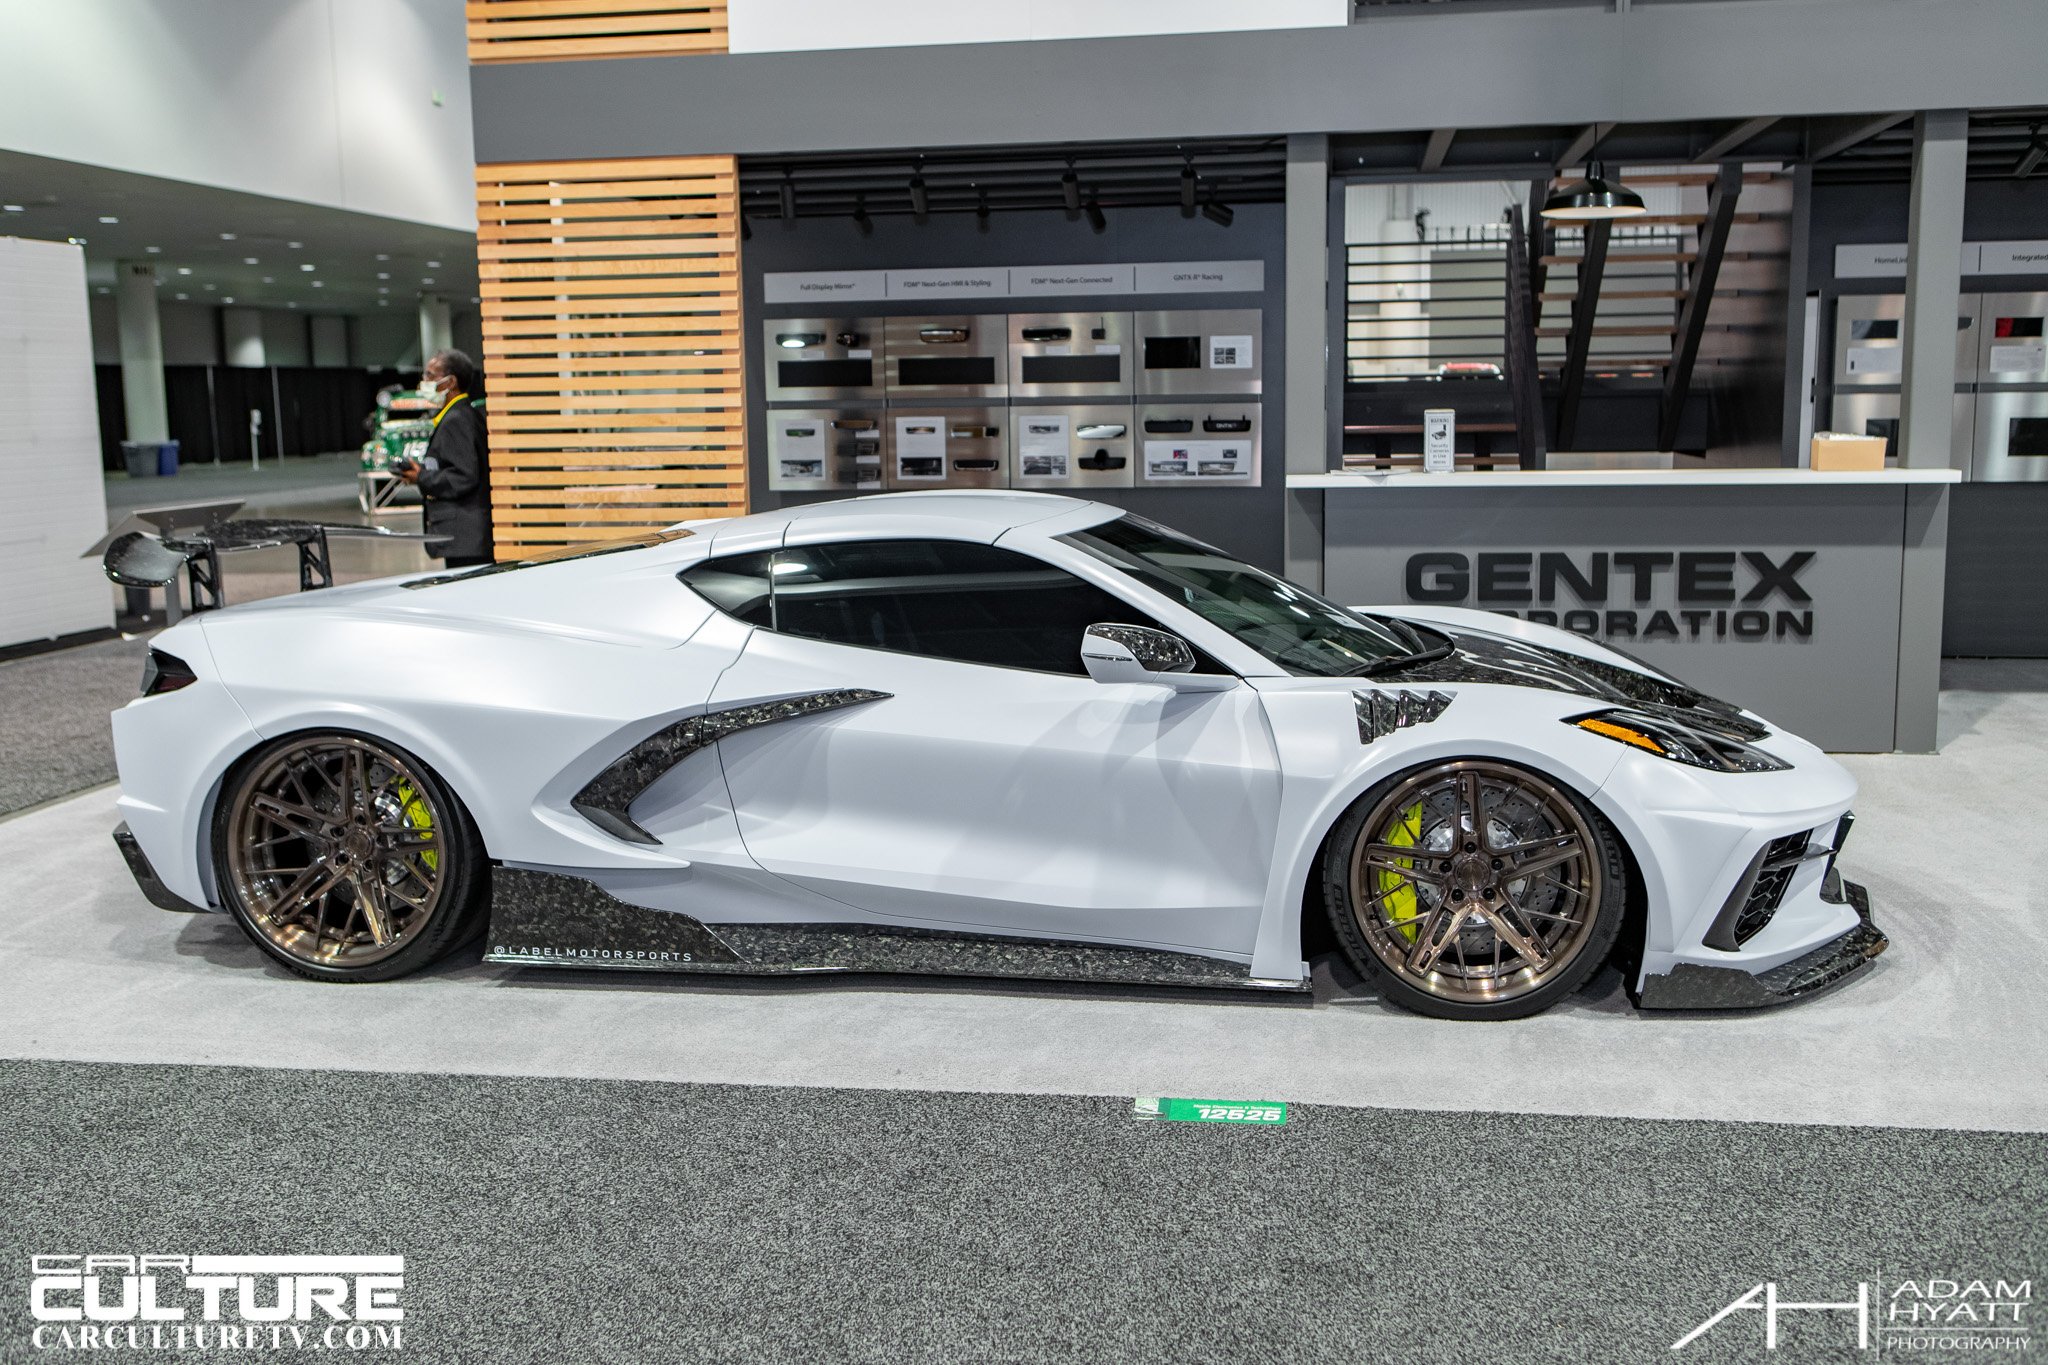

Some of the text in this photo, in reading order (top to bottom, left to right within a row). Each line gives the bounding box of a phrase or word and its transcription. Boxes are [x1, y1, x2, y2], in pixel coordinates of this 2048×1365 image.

[811, 283, 833, 291] Display
[971, 279, 992, 287] Styling
[1406, 551, 1817, 602] GENTEX
[1498, 609, 1814, 637] PORATION
[1199, 1108, 1282, 1121] 12525
